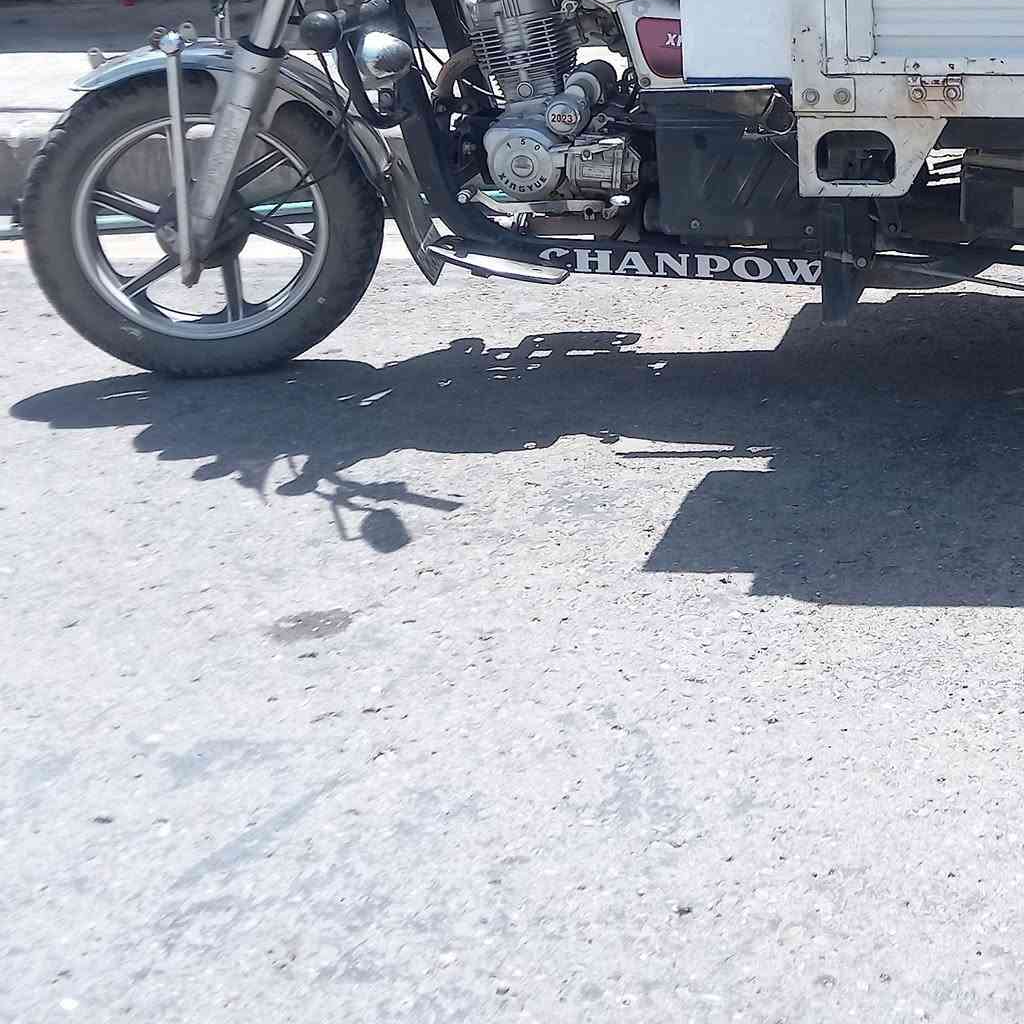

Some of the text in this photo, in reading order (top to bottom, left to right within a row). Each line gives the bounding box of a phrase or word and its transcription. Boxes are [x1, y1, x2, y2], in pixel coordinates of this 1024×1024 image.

[550, 113, 574, 124] 2023
[506, 136, 541, 152] 150
[497, 172, 548, 194] XINGYUE
